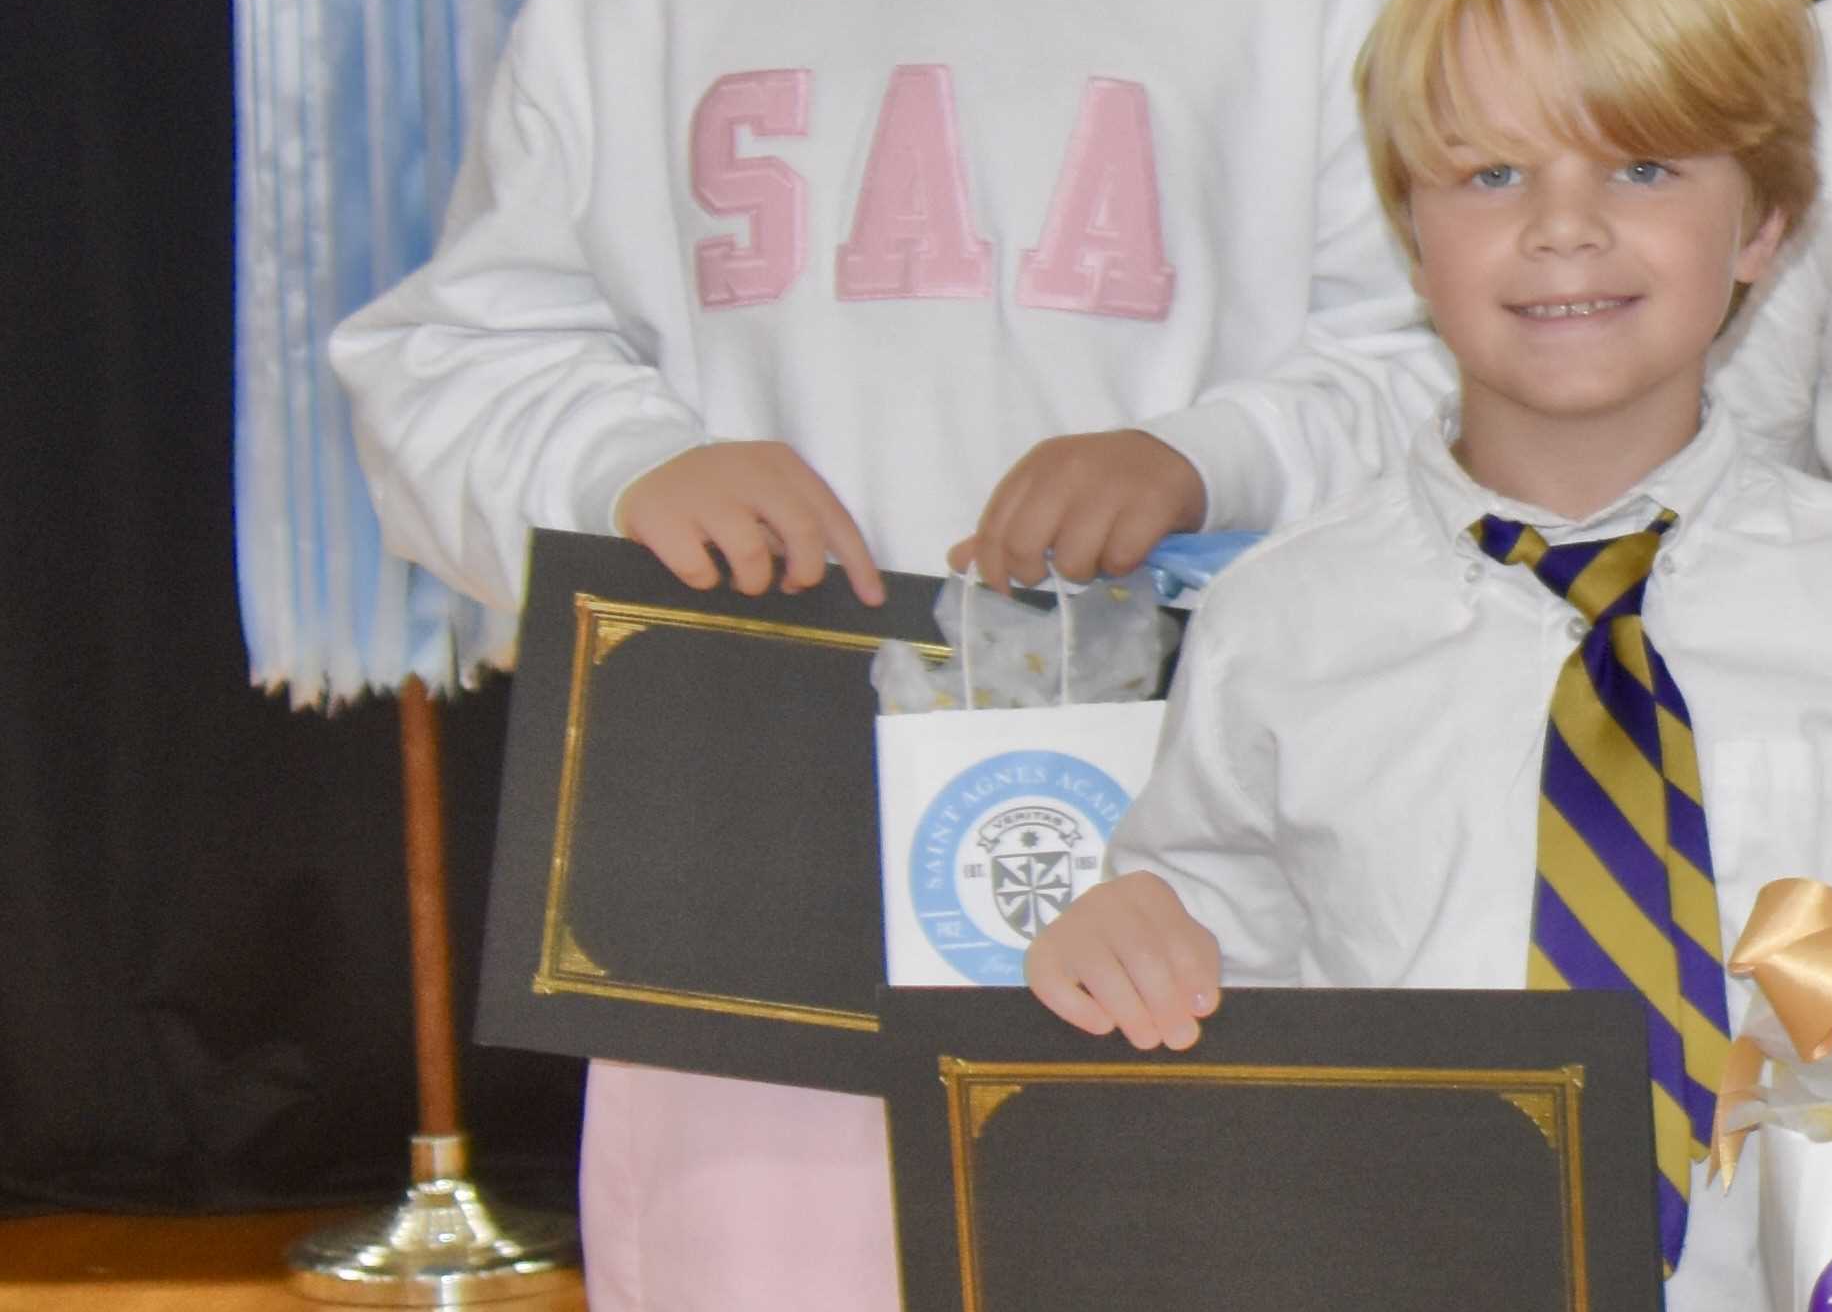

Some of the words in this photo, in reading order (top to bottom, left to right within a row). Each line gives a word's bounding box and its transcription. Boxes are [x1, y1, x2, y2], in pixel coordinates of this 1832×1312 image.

[688, 63, 1177, 323] SAA
[925, 804, 961, 890] SAINT
[961, 765, 1049, 804] AGNES
[1055, 770, 1120, 823] ACAD
